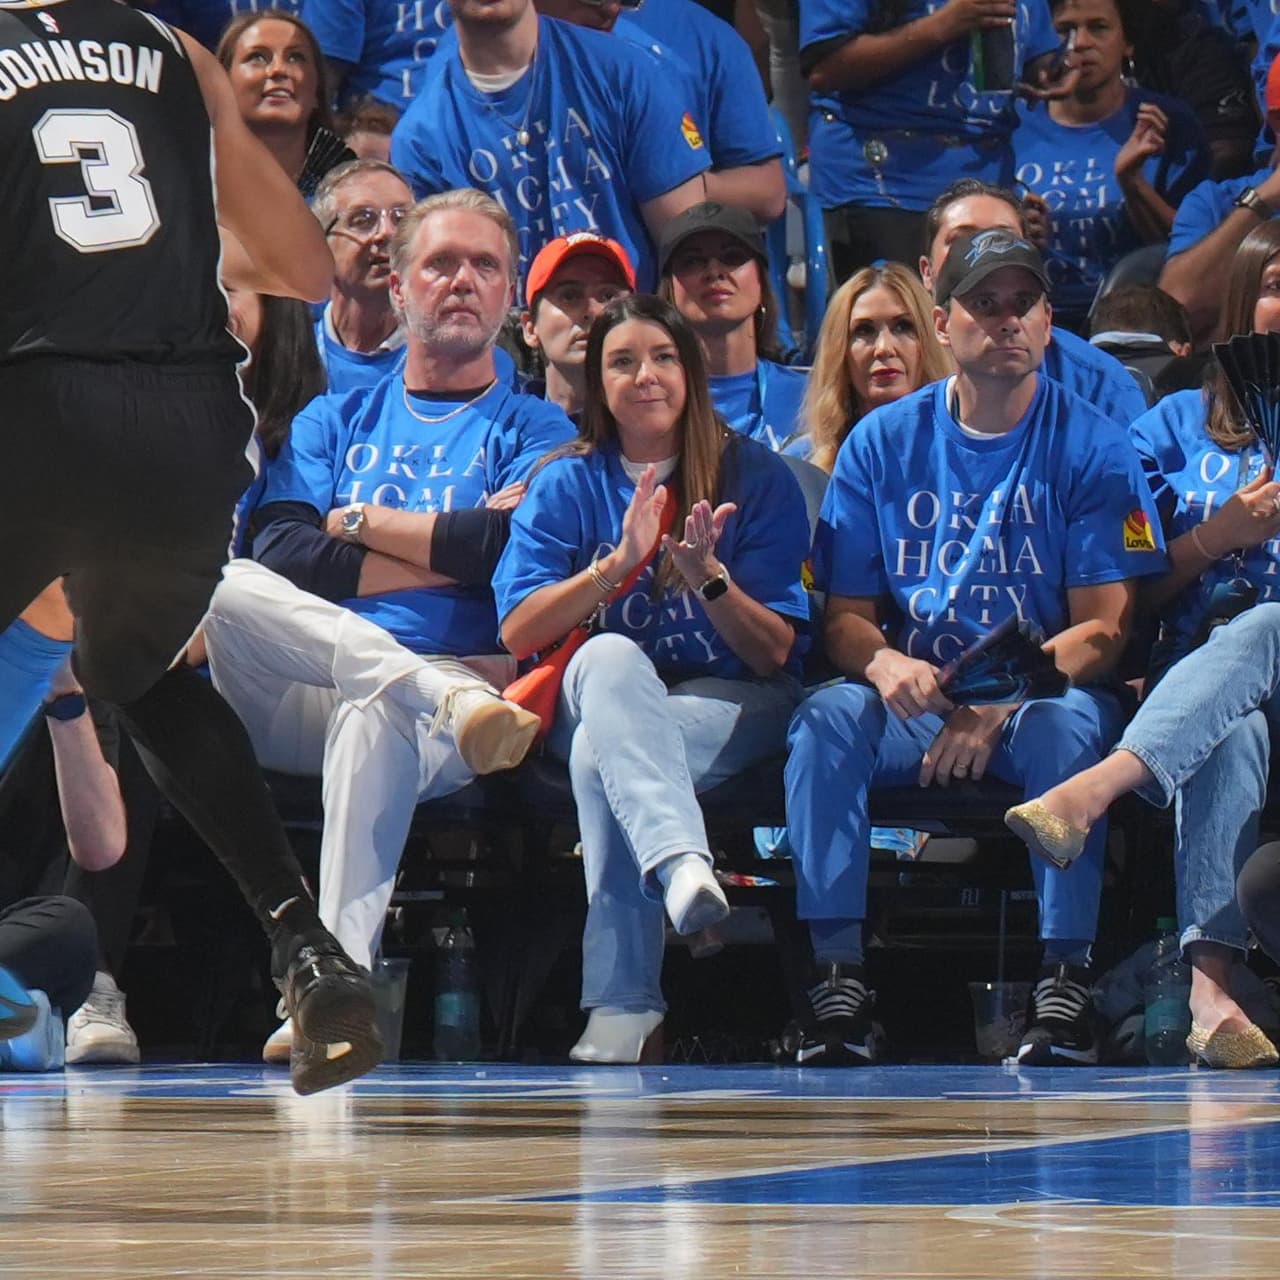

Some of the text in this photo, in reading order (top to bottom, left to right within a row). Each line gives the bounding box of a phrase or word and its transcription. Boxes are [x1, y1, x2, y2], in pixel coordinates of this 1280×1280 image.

[32, 108, 161, 254] 3
[1016, 161, 1102, 187] OKL
[345, 443, 485, 478] OKLA
[907, 484, 1034, 529] OKLA
[896, 535, 1044, 577] HOMA
[908, 584, 1029, 624] CITY
